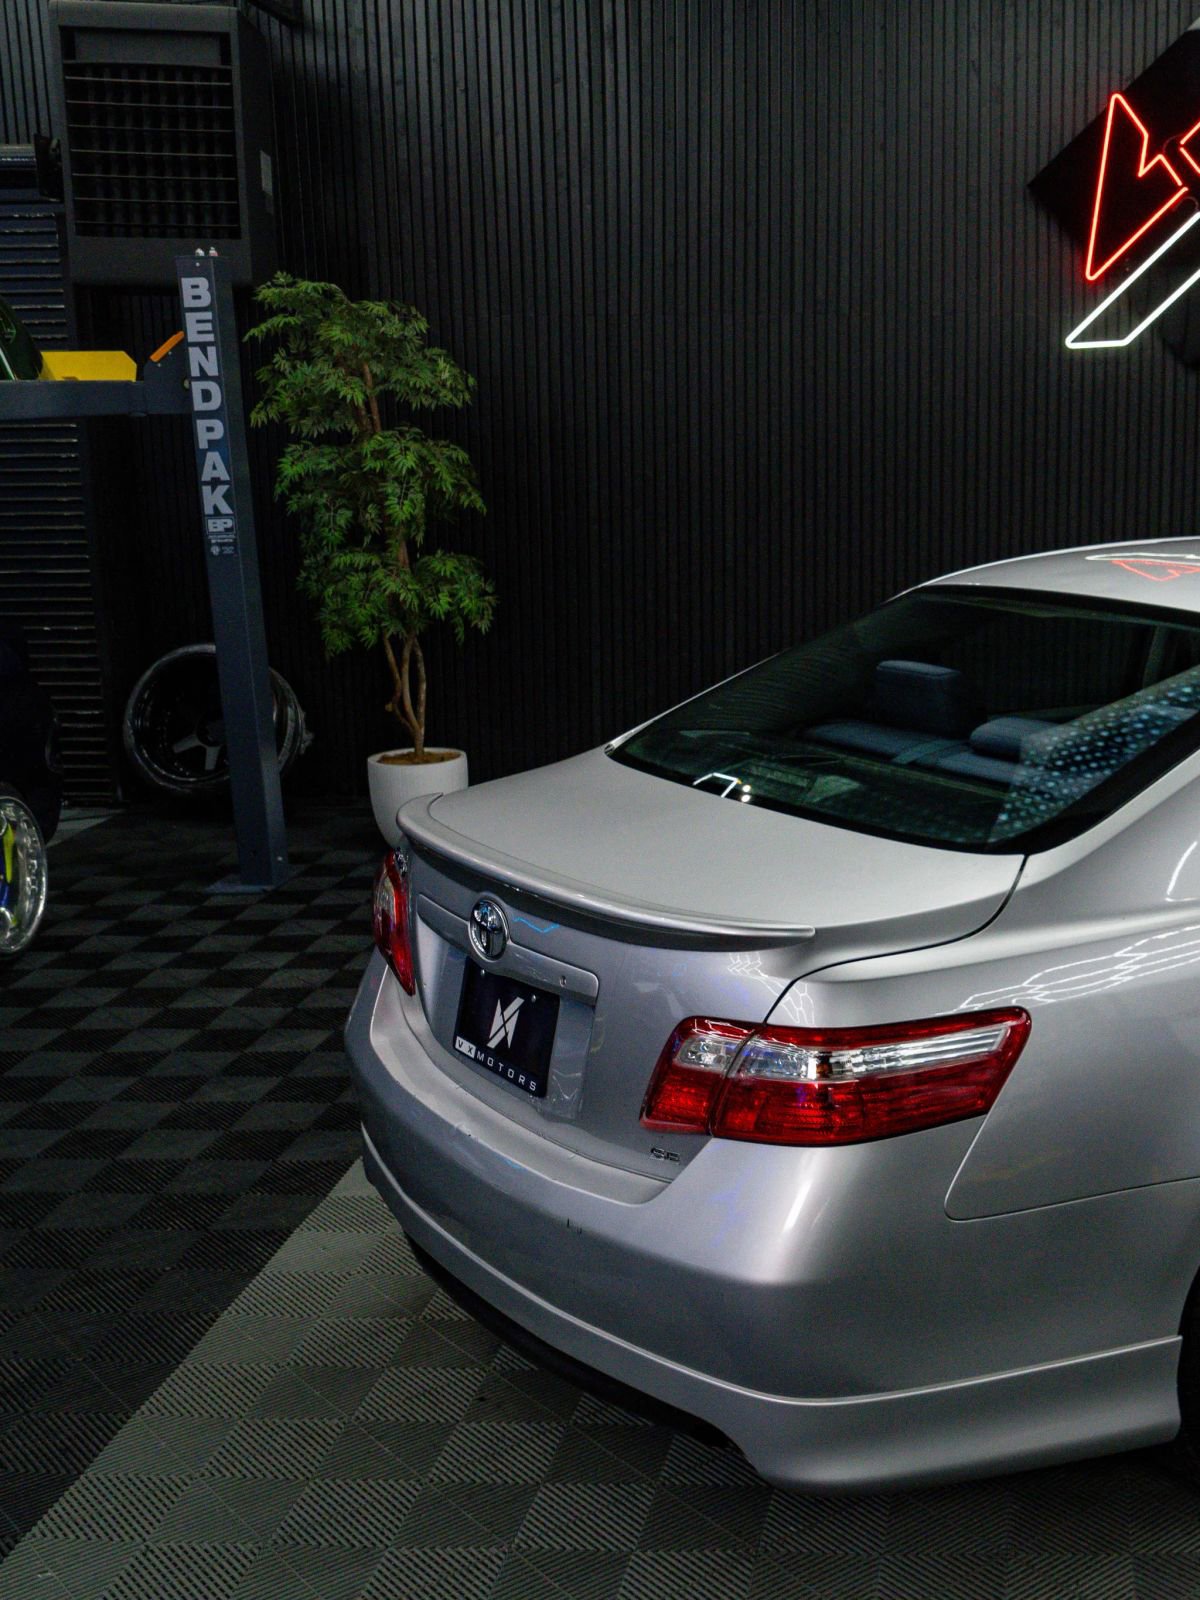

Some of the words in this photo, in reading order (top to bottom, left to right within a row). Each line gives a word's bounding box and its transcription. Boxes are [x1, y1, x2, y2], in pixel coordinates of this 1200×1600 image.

[181, 277, 234, 515] BENDPAK
[208, 518, 233, 532] BP
[477, 1051, 537, 1091] MOTORS
